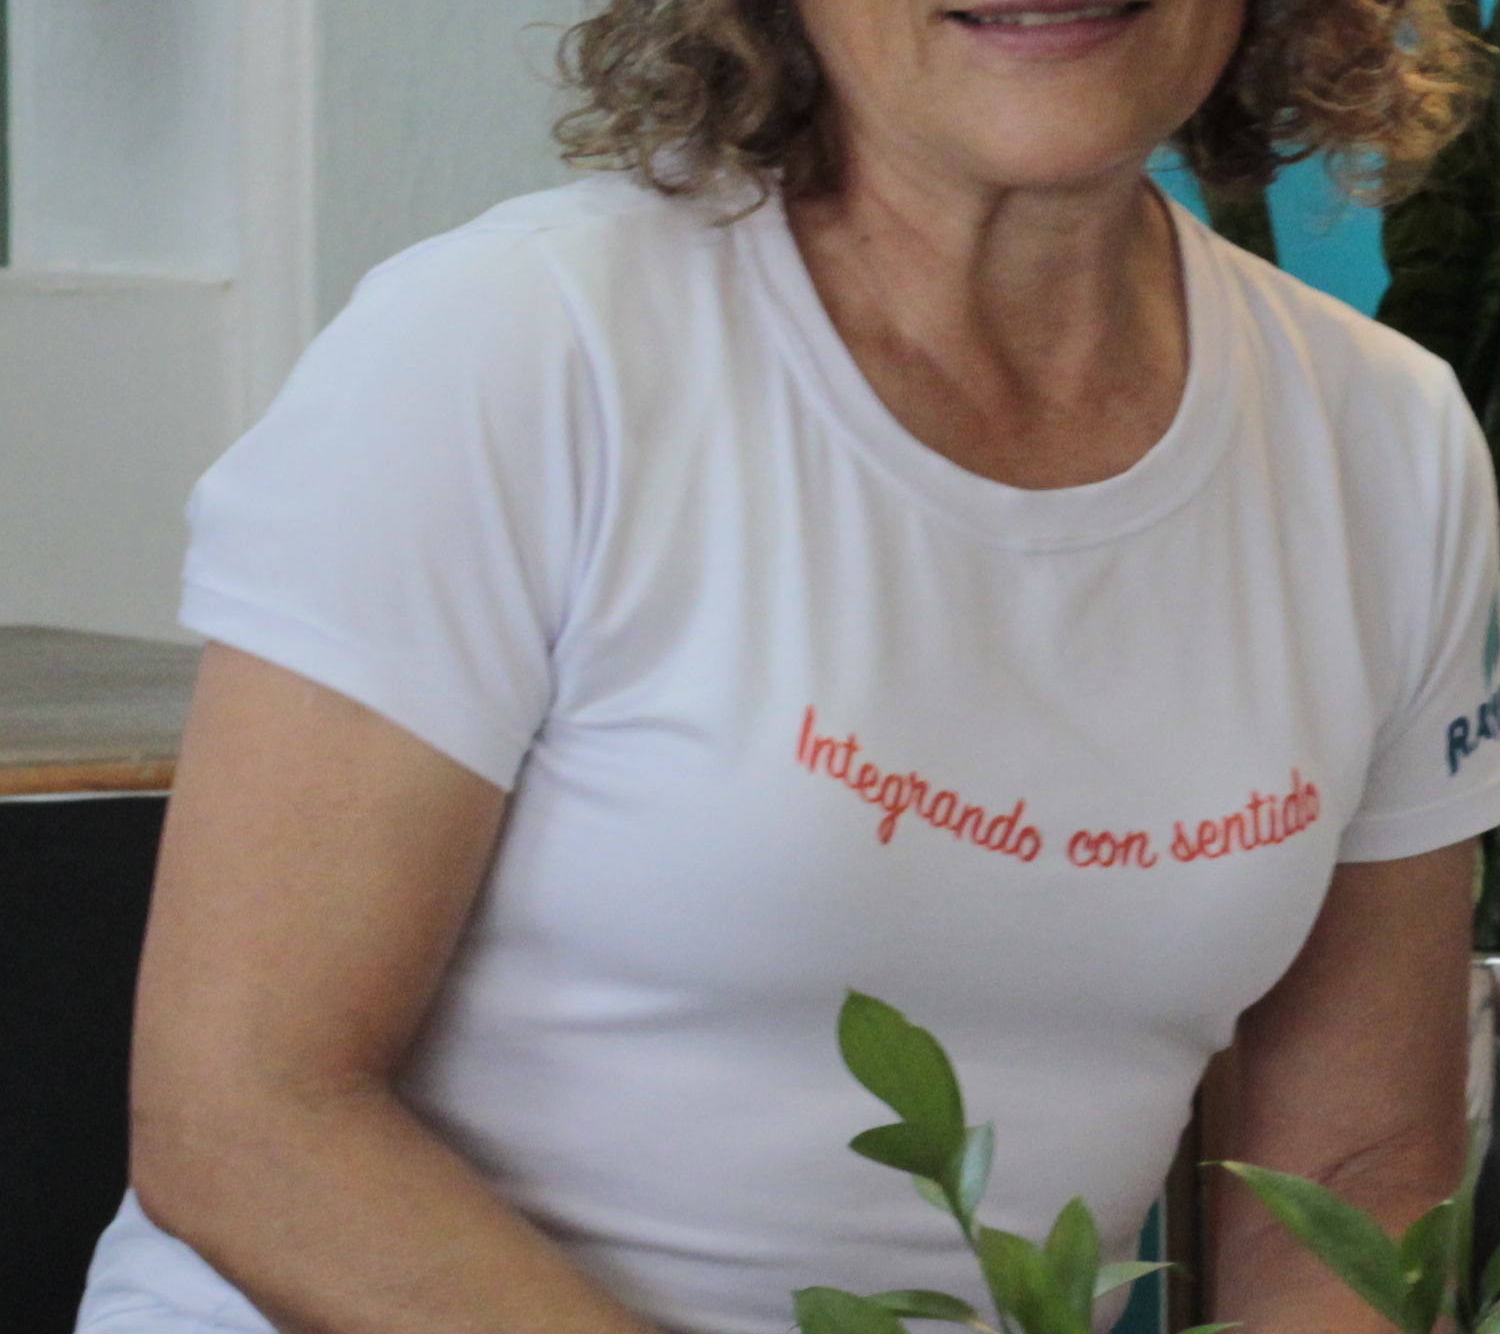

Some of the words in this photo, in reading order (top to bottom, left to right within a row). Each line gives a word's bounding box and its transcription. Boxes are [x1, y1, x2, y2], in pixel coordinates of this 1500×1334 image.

[796, 703, 1043, 862] Integrando
[1067, 827, 1159, 869] con
[1169, 765, 1321, 862] sentido
